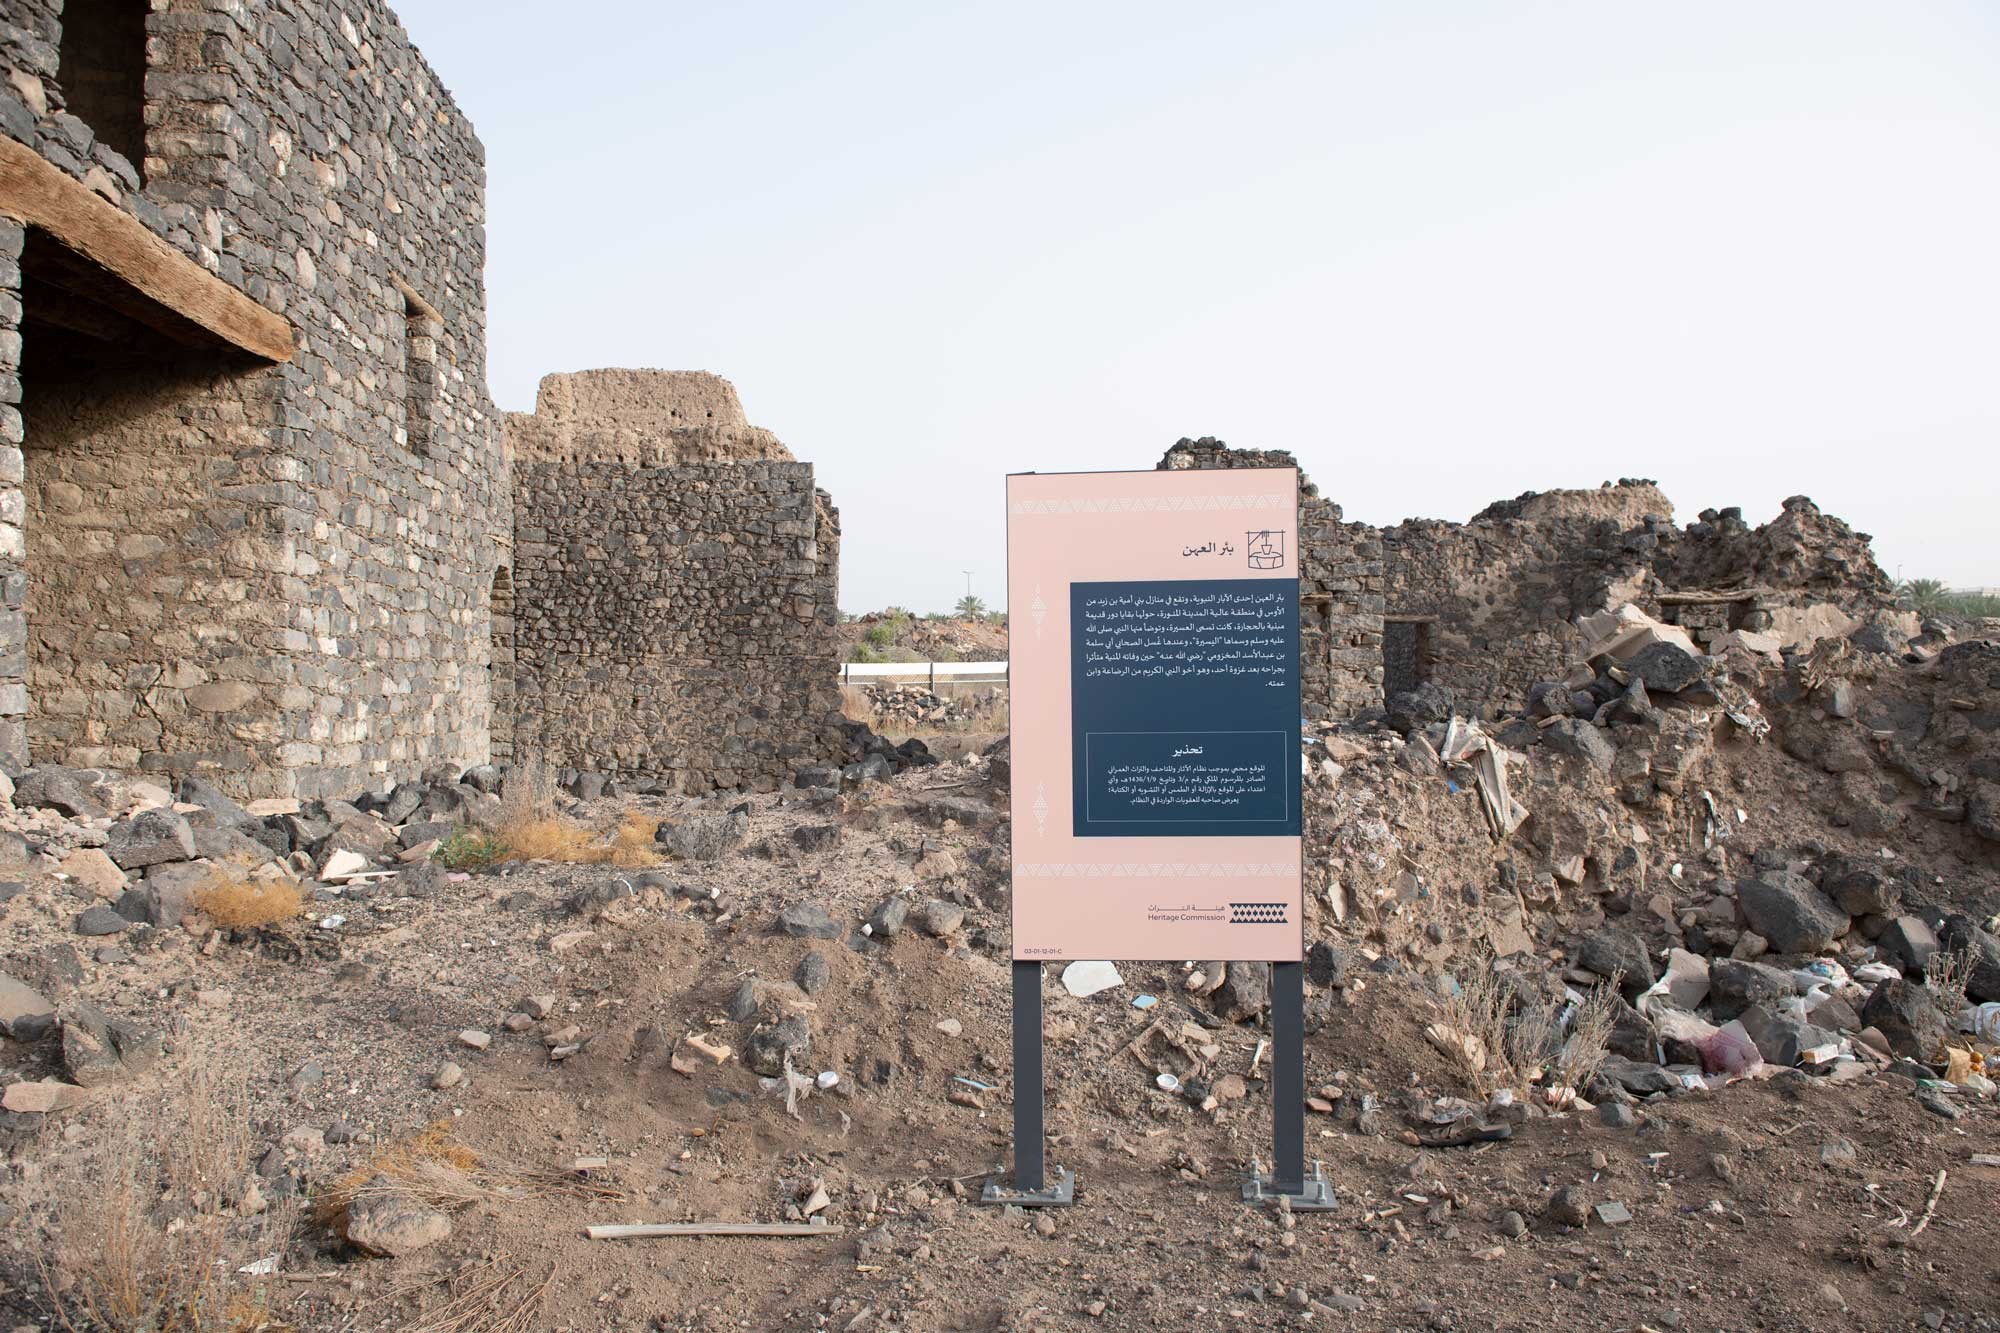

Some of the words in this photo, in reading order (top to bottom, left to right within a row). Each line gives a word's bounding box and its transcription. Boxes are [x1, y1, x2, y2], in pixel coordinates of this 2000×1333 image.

[1183, 542, 1216, 556] العهن
[1218, 541, 1234, 556] بئر
[1098, 598, 1108, 606] زيد
[1119, 595, 1133, 605] أمية
[1134, 598, 1145, 606] بني
[1146, 596, 1164, 604] منازل
[1165, 595, 1172, 605] في
[1173, 597, 1188, 606] وتقع
[1216, 594, 1232, 603] الآبار
[1234, 594, 1253, 603] إحدى
[1255, 594, 1274, 603] العهن
[1275, 594, 1284, 602] بئر
[1086, 611, 1105, 619] قديمة
[1120, 611, 1134, 619] بقايا
[1136, 610, 1155, 619] حولها
[1182, 609, 1209, 618] المدينة
[1210, 609, 1229, 617] عالية
[1256, 608, 1263, 618] في
[1264, 606, 1284, 617] الأوس
[1086, 624, 1096, 632] الله
[1098, 625, 1112, 634] صلى
[1114, 624, 1129, 635] النبي
[1130, 625, 1142, 633] منها
[1144, 623, 1165, 633] وتوضأ
[1196, 624, 1214, 632] تسمى
[1267, 622, 1284, 631] مبنية
[1105, 638, 1113, 648] أبي
[1115, 638, 1142, 648] الصحابي
[1224, 637, 1248, 646] وسماها
[1250, 637, 1268, 646] وسلم
[1270, 637, 1284, 645] عليه
[1105, 653, 1121, 661] المنية
[1175, 651, 1185, 659] الله
[1207, 651, 1240, 662] المخزومي
[1086, 668, 1101, 676] وابن
[1102, 667, 1130, 676] الرضاعة
[1143, 666, 1164, 676] الكريم
[1165, 666, 1180, 677] النبي
[1182, 665, 1195, 675] أخو
[1229, 666, 1246, 675] غزوة
[1261, 665, 1285, 674] بجراحه
[1172, 744, 1203, 757] تحذير
[1192, 765, 1207, 773] نظام
[1249, 765, 1266, 774] الموقع
[1218, 786, 1234, 795] الموقع
[1148, 914, 1179, 922] Heritage
